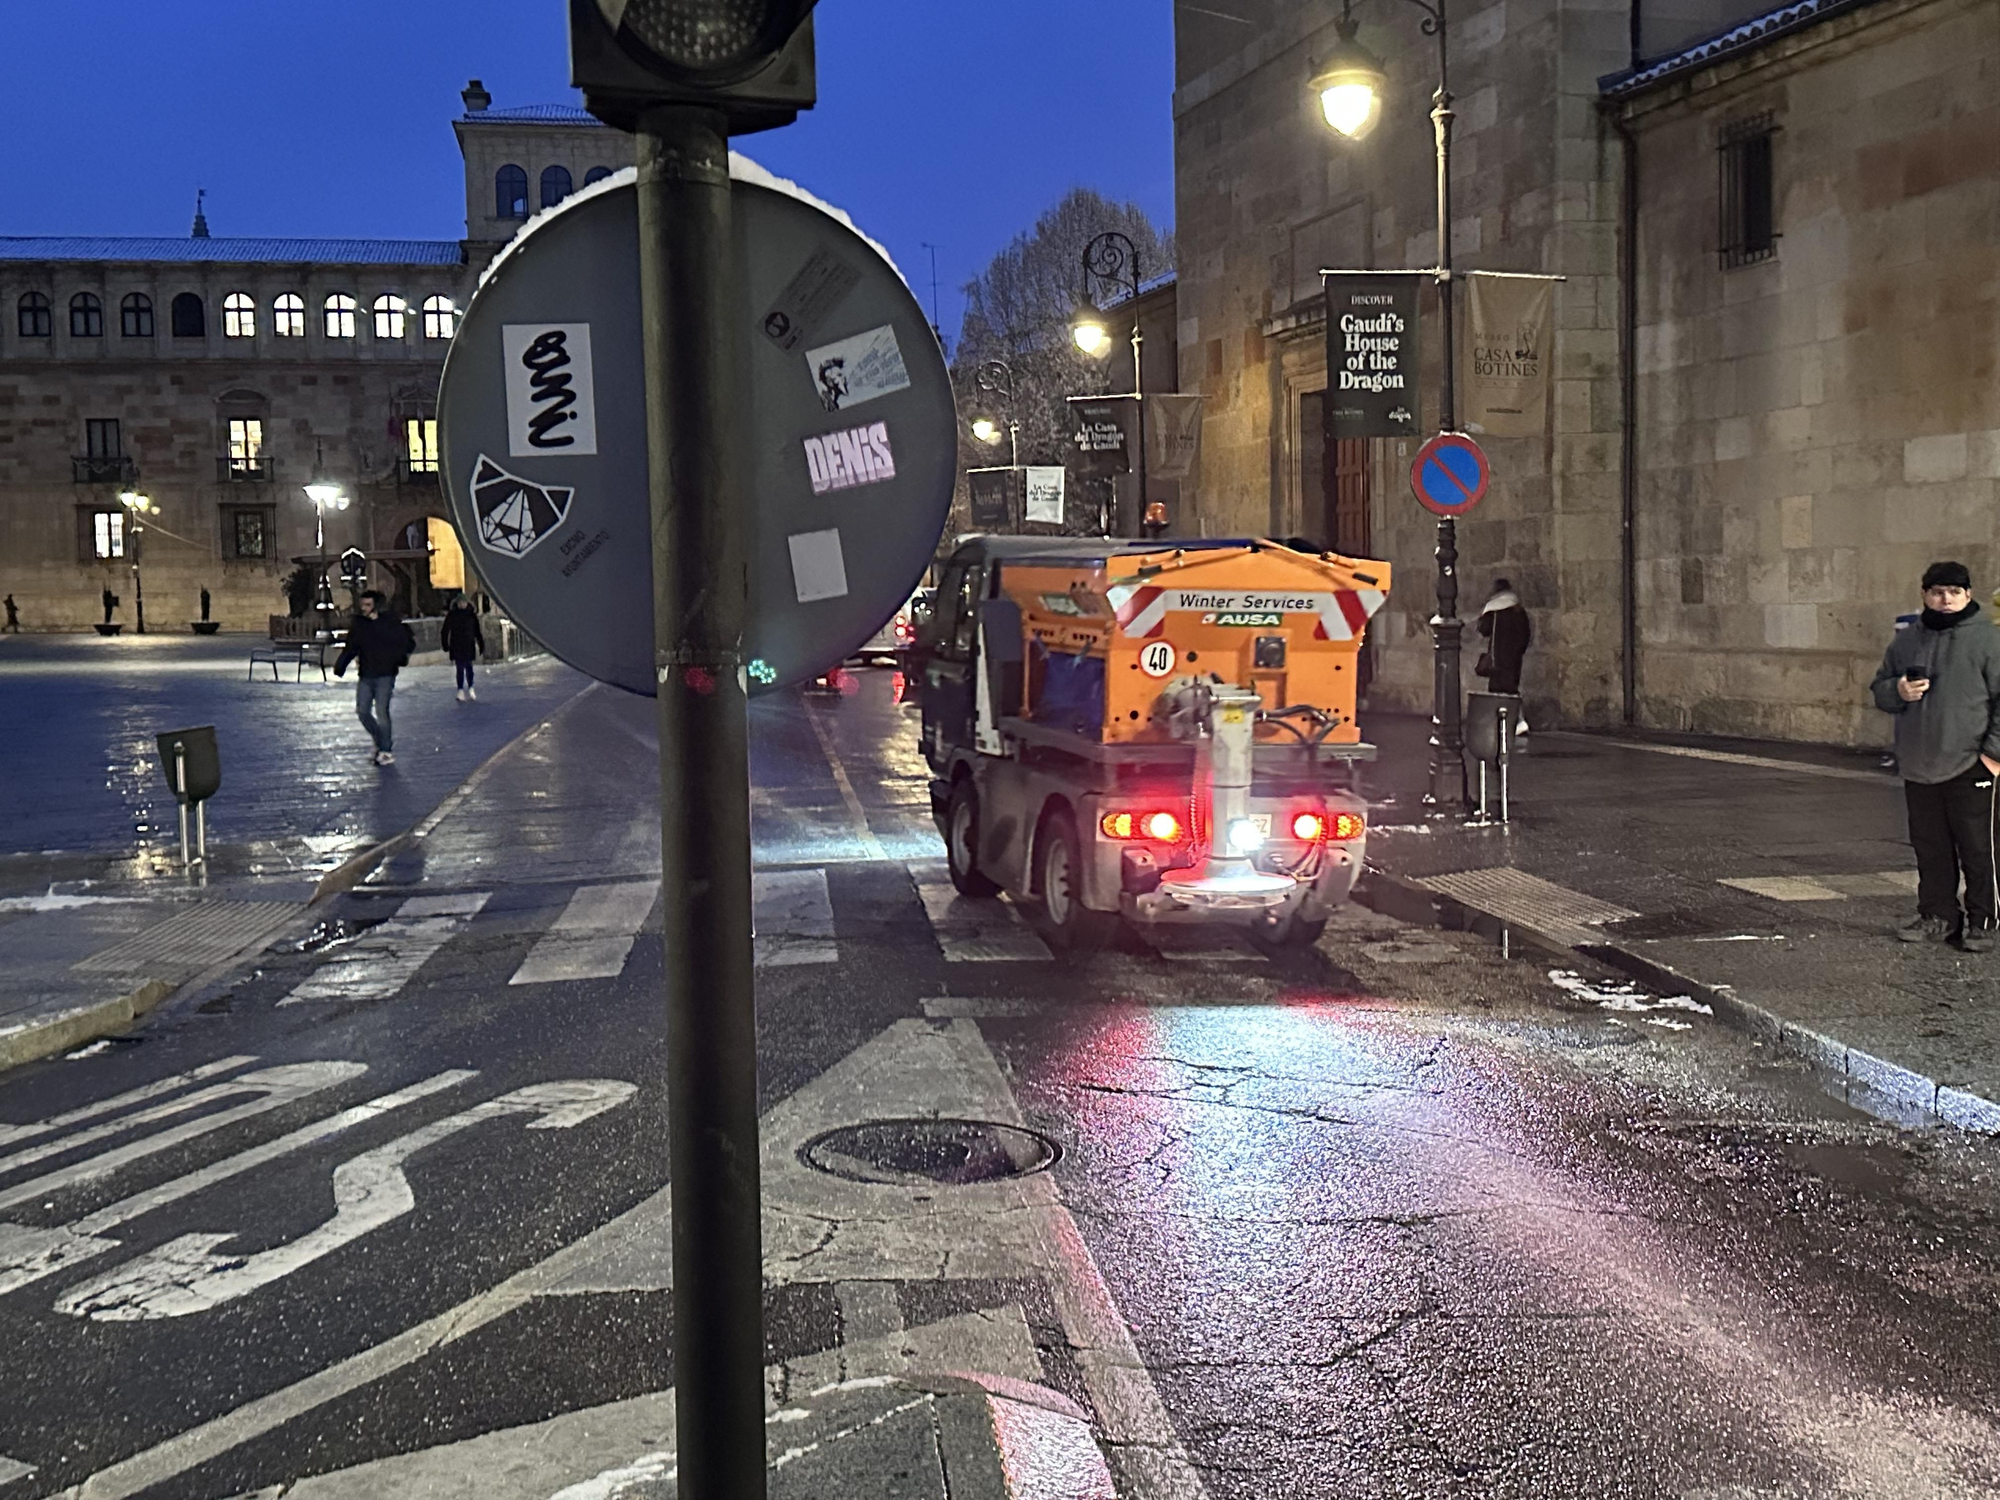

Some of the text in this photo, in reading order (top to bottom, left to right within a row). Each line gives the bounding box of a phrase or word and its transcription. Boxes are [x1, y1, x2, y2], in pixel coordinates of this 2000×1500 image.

[1351, 295, 1393, 305] DISCOVER
[1345, 334, 1399, 352] House
[1346, 351, 1397, 370] of the
[1474, 347, 1512, 362] CASA
[1474, 361, 1538, 376] BOTINES
[1339, 371, 1404, 393] Dragon
[1180, 594, 1314, 609] Winter Services
[1217, 615, 1280, 625] AUSA
[1149, 647, 1167, 670] 40
